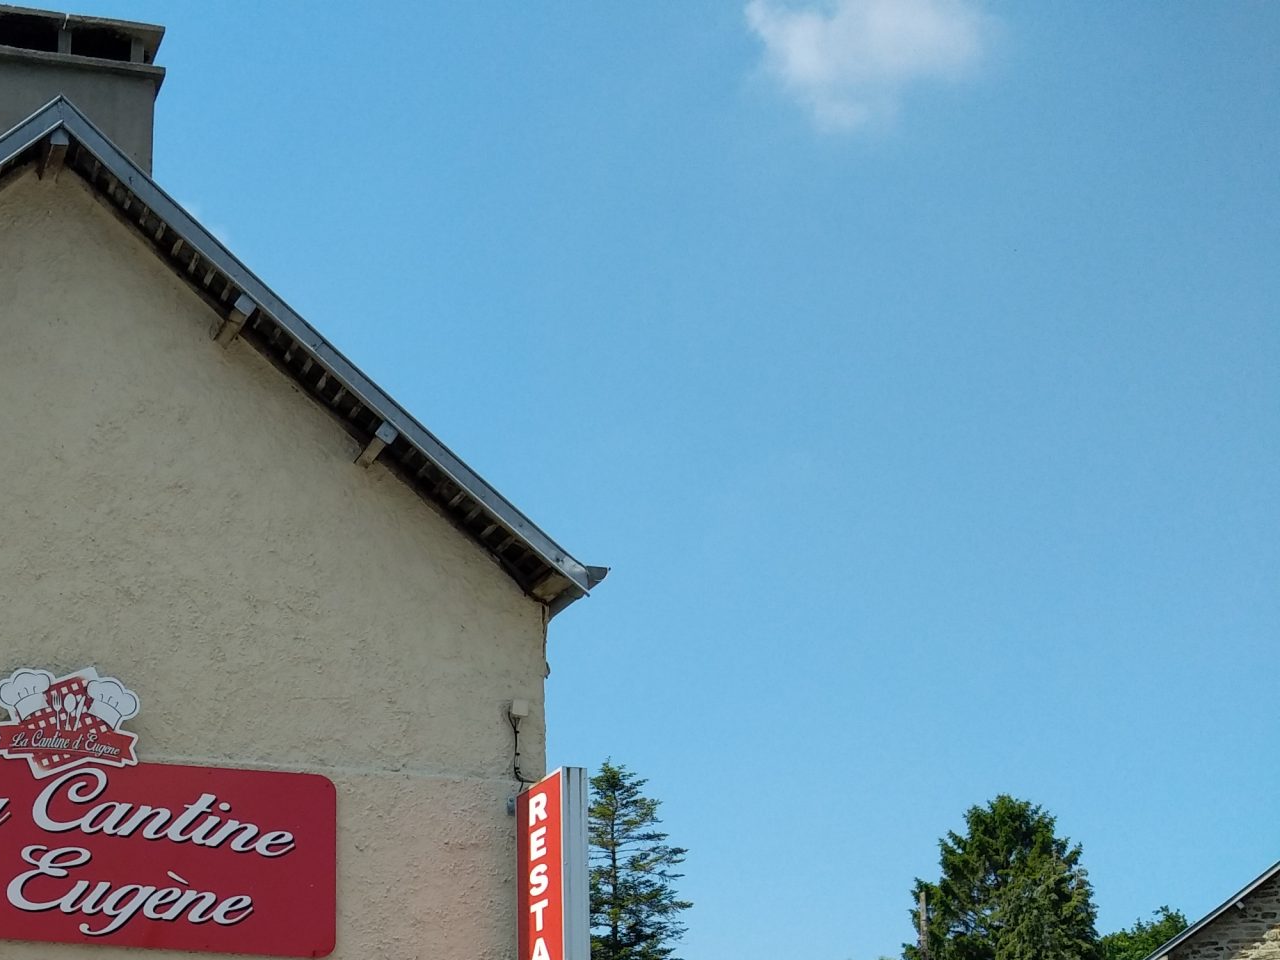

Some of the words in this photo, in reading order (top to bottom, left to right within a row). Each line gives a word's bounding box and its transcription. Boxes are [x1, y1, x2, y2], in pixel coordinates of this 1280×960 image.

[10, 731, 29, 747] La
[31, 729, 70, 749] Cantine
[32, 767, 296, 857] Cantine
